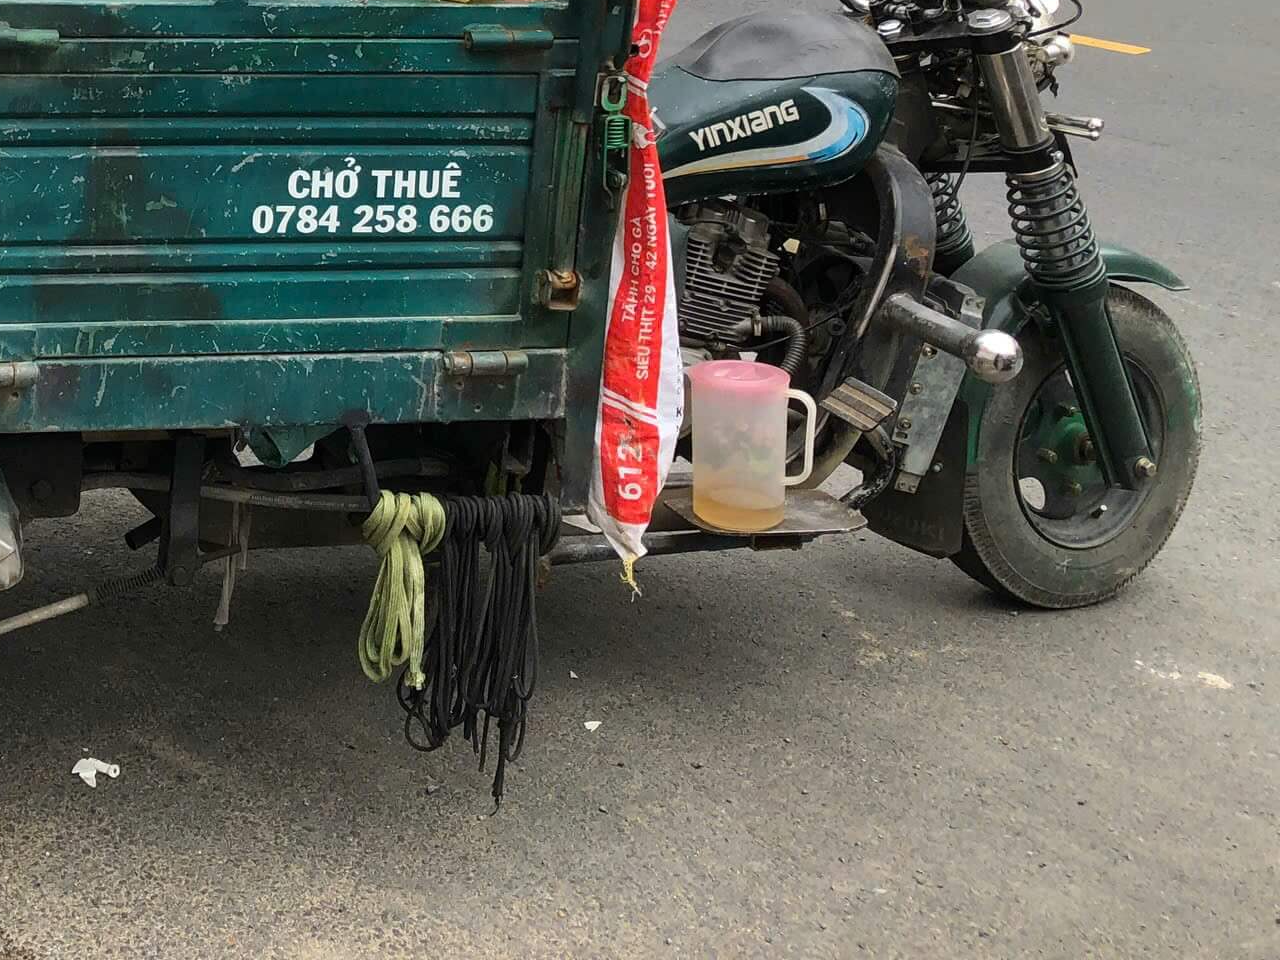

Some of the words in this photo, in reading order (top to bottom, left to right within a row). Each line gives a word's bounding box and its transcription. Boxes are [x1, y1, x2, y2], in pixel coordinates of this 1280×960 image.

[287, 156, 362, 200] CHỞ
[371, 162, 463, 200] THUÊ
[252, 204, 340, 234] 0784
[352, 204, 418, 234] 258
[428, 204, 495, 234] 666
[631, 242, 642, 276] CHO
[646, 250, 658, 271] 42
[644, 286, 656, 304] 29
